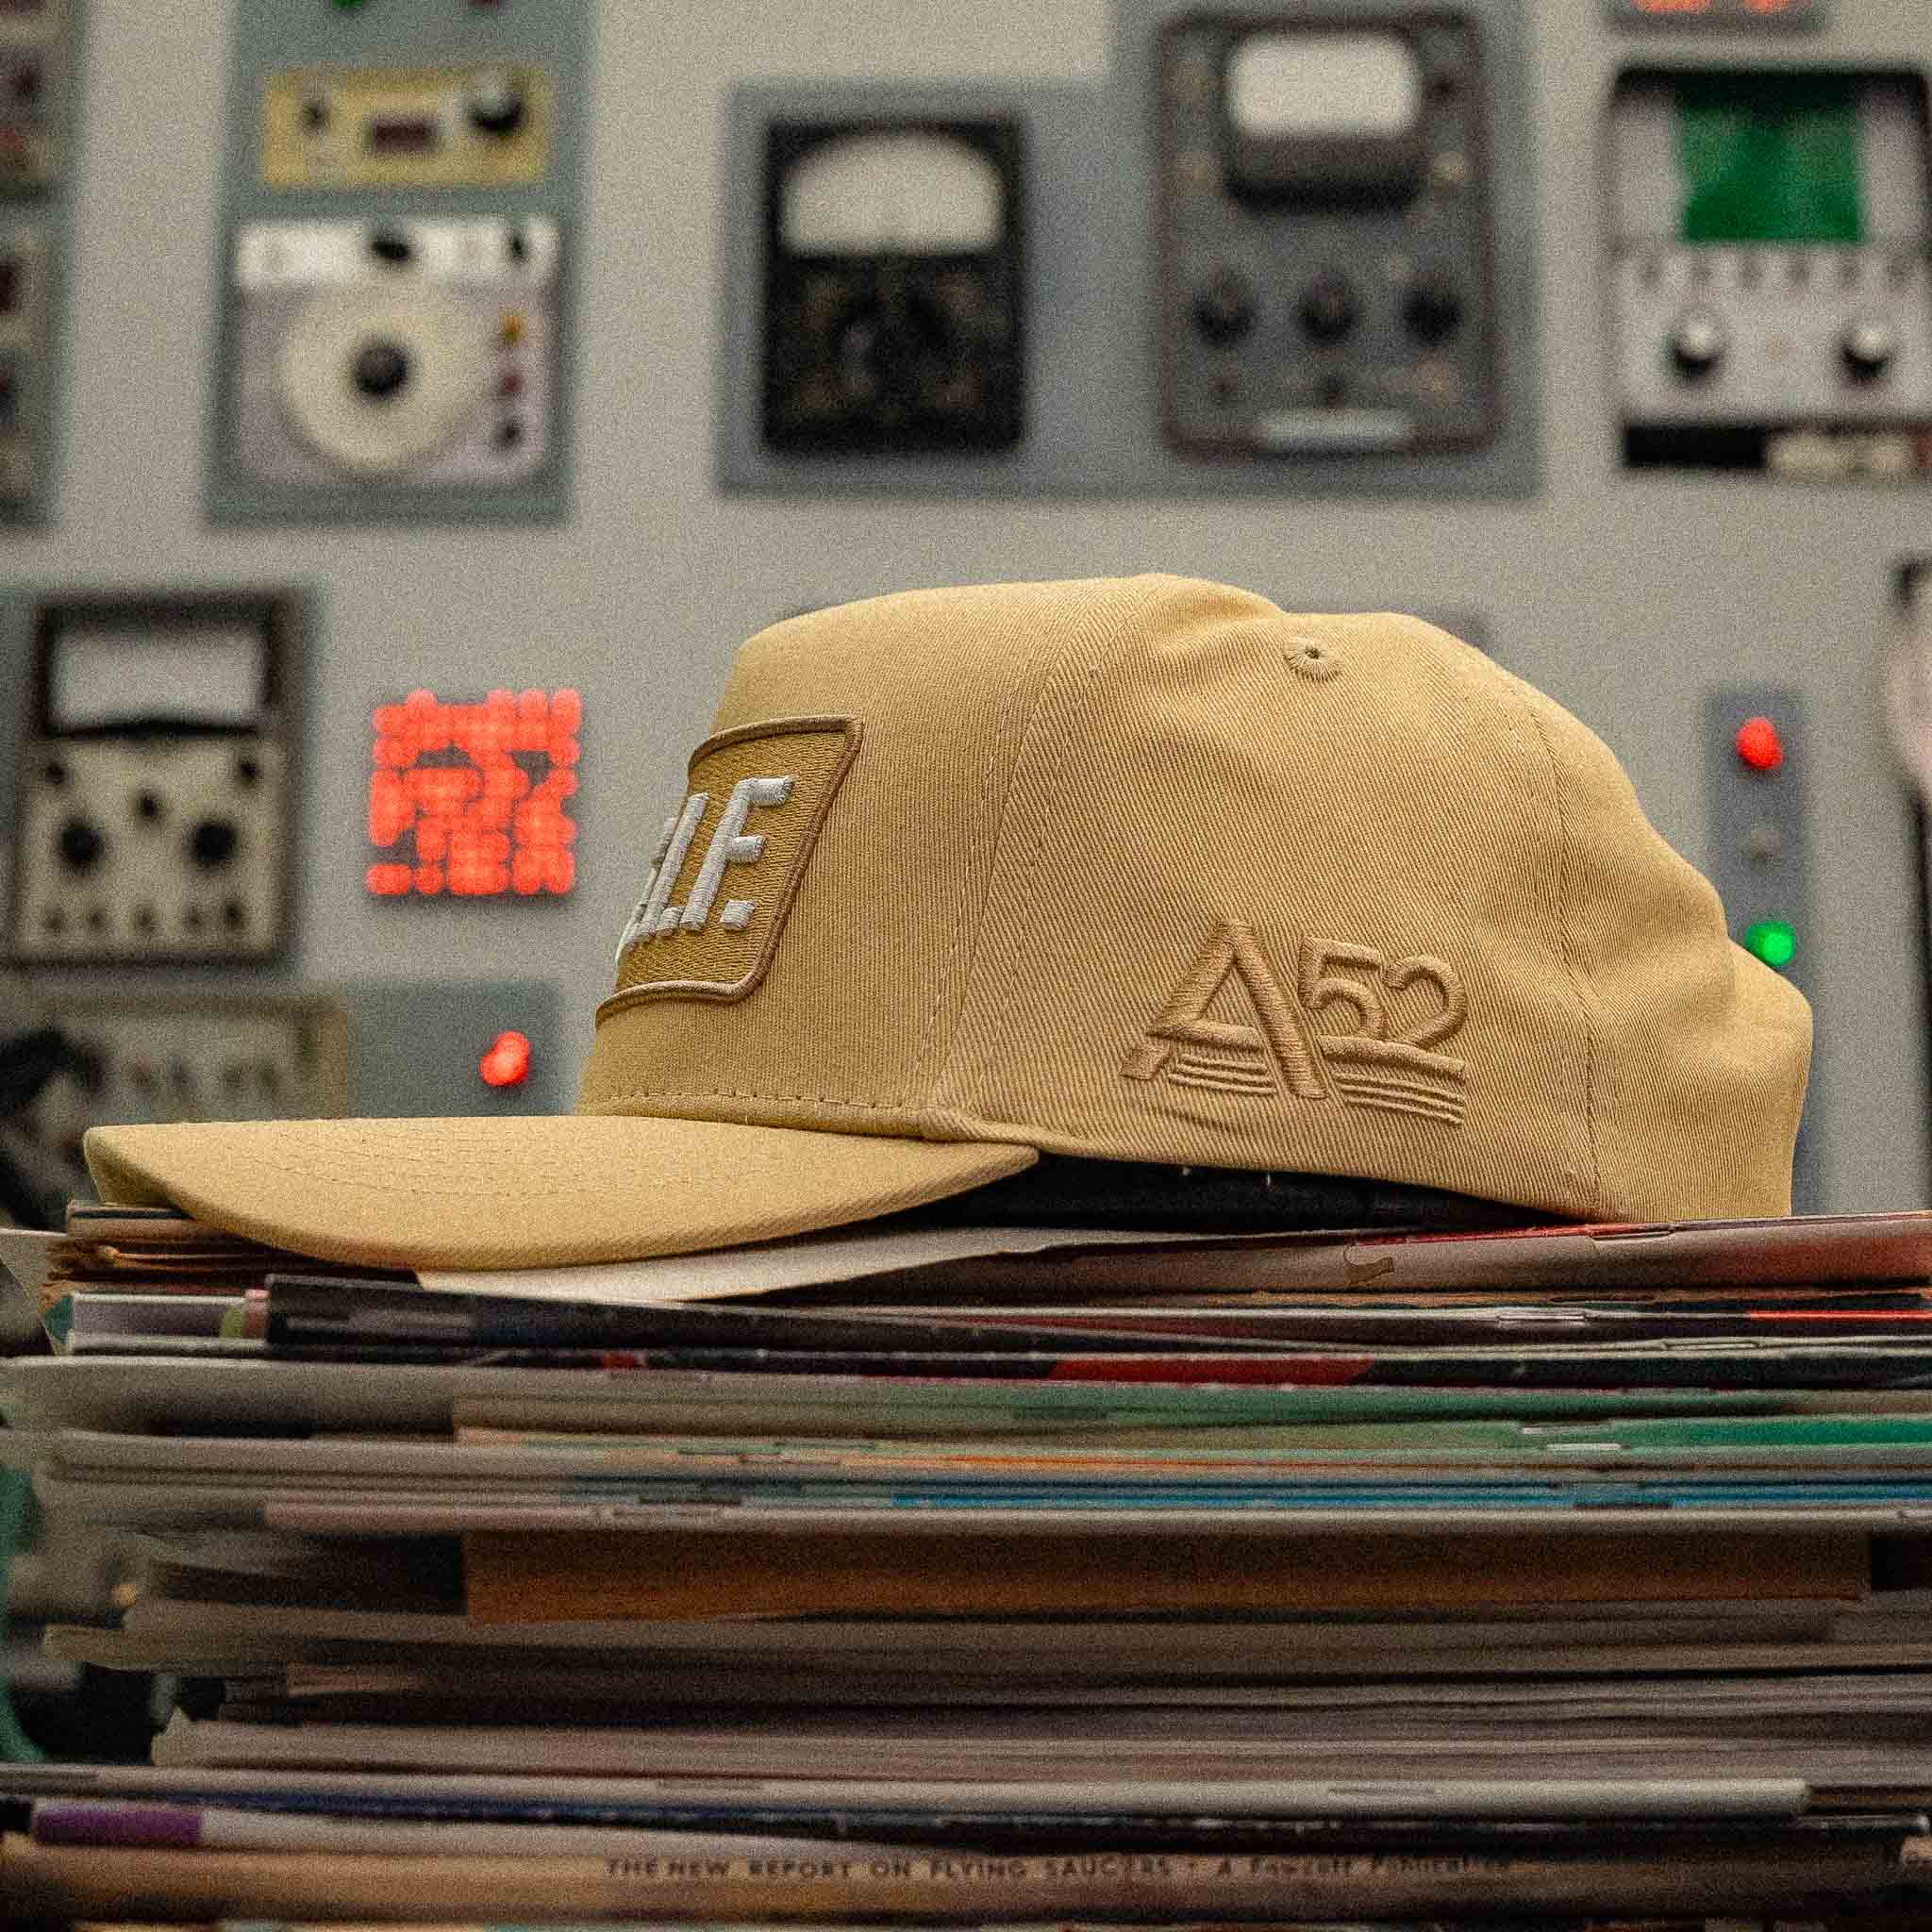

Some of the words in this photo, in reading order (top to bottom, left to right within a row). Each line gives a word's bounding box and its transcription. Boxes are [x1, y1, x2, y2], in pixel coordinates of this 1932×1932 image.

[1120, 920, 1468, 1099] A52
[608, 1858, 657, 1878] THE
[669, 1858, 730, 1878] NEW
[748, 1858, 851, 1878] REPORT
[870, 1858, 910, 1878] ON
[930, 1858, 1026, 1878] FLYING
